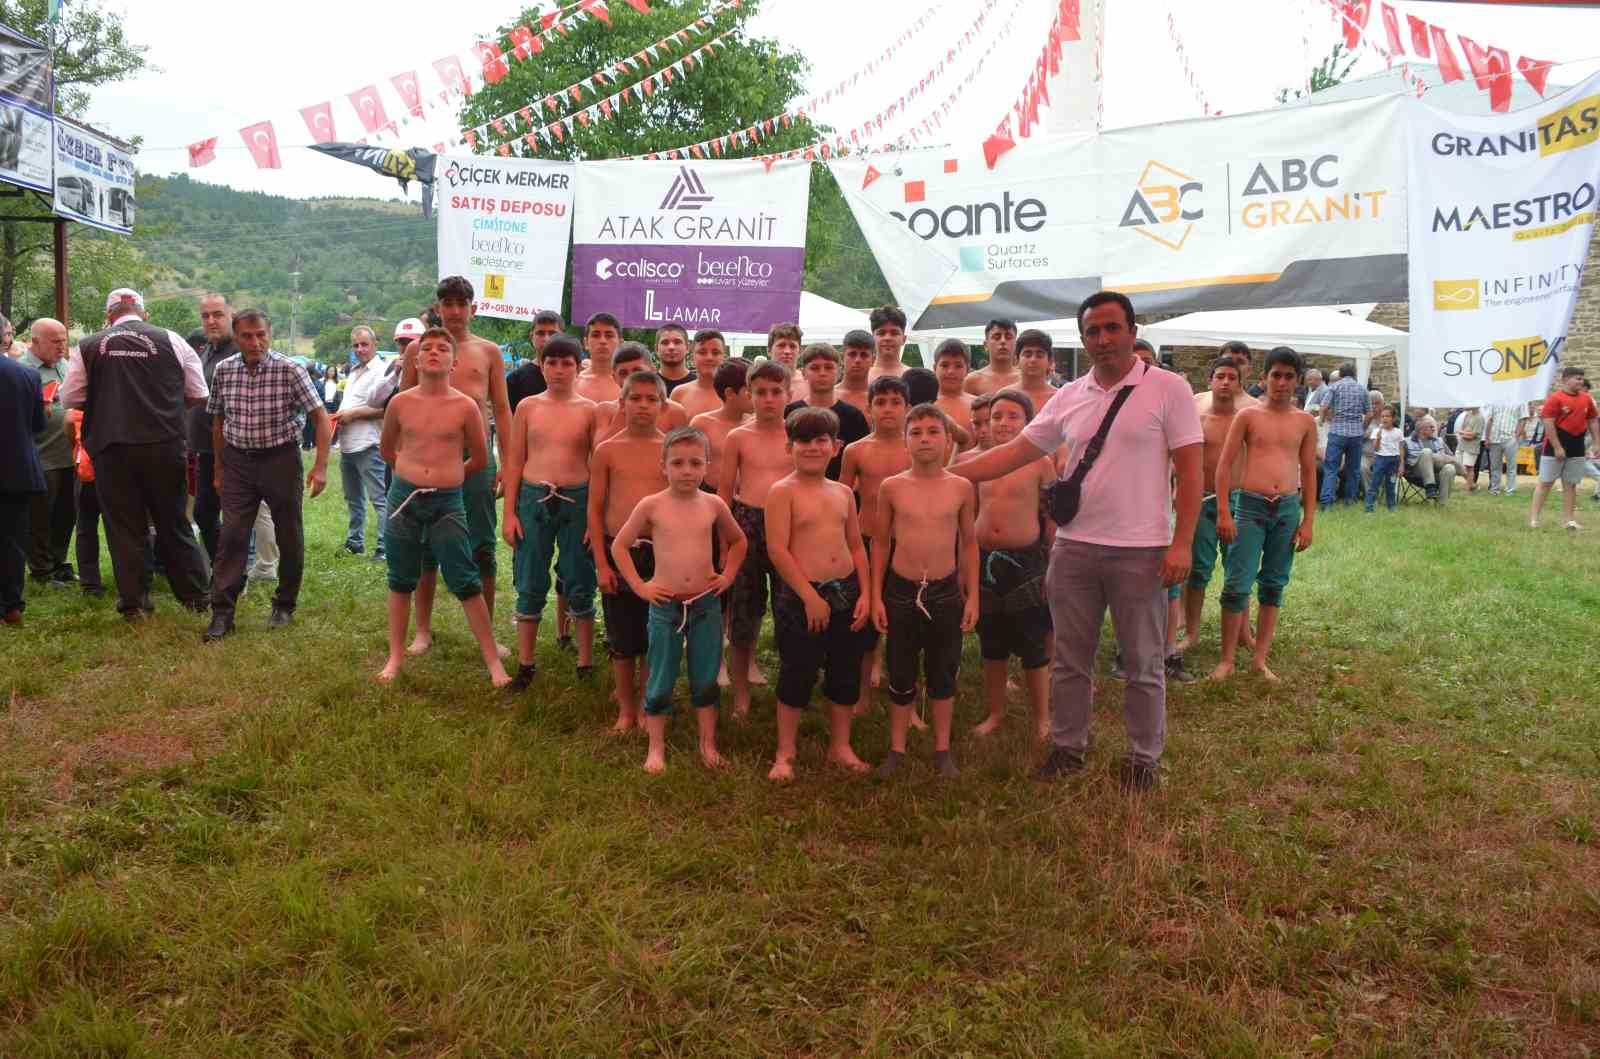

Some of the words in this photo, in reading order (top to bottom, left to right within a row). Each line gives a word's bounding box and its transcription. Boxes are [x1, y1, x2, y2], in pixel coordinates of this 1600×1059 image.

[506, 172, 570, 189] MERMER
[1242, 154, 1339, 196] ABC
[451, 196, 496, 214] SATIŞ
[500, 200, 566, 217] DEPOSU
[1432, 183, 1595, 232] MAESTRO
[598, 216, 664, 239] ATAK
[987, 244, 1037, 257] Quartz
[988, 256, 1049, 270] Surfaces
[1485, 263, 1584, 295] INFINITY
[665, 305, 721, 322] LAMAR
[1443, 336, 1566, 376] STONEX
